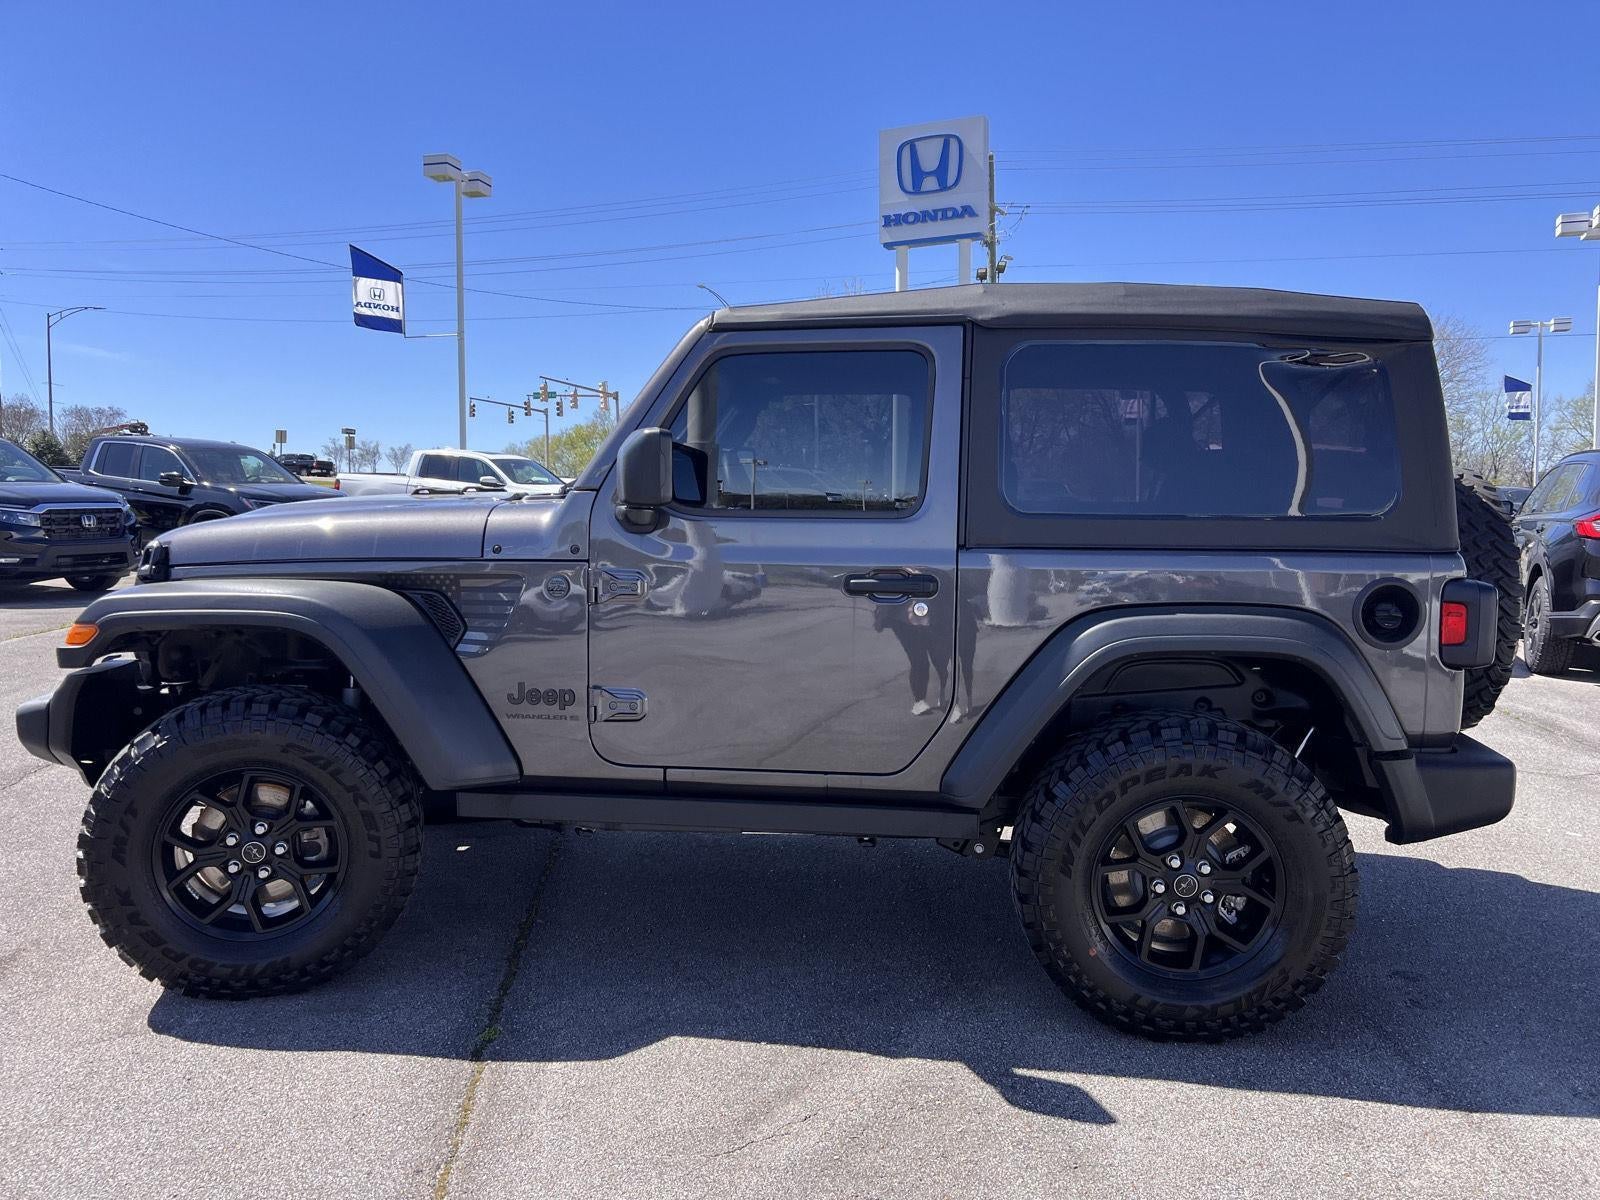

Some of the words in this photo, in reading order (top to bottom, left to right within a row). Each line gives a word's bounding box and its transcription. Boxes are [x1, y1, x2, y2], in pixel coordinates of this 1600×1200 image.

[881, 204, 979, 228] HONDA
[506, 681, 576, 711] Jeep
[505, 712, 568, 721] WRANGLER
[1058, 762, 1229, 880] WILDPEAK
